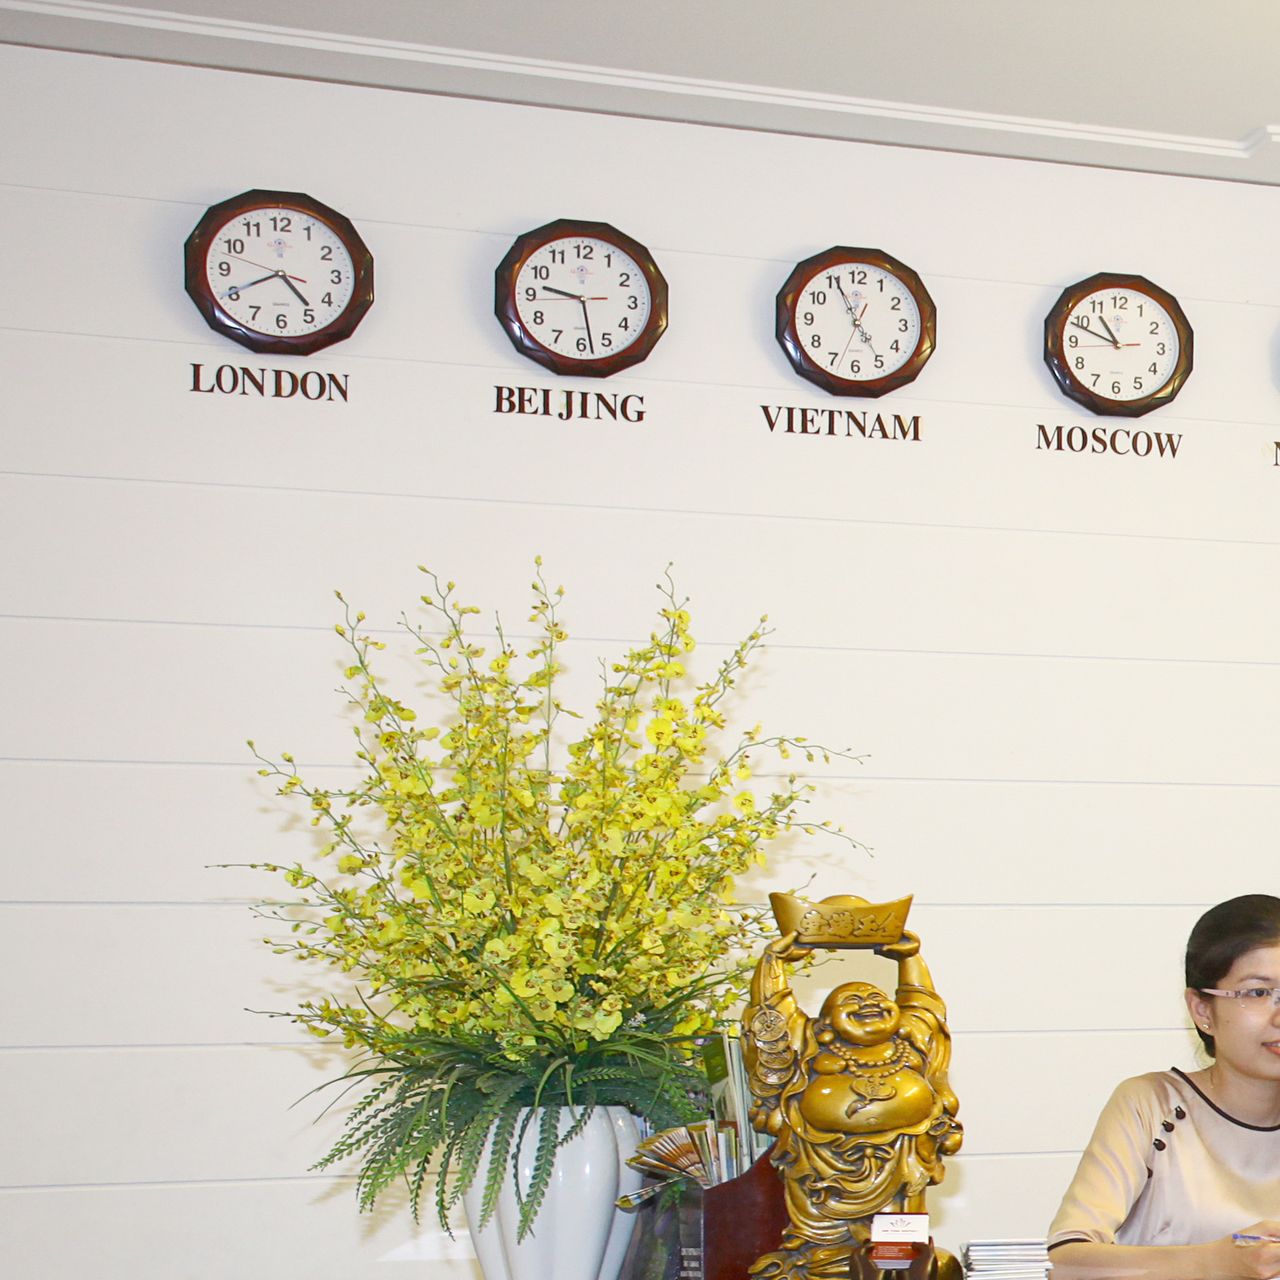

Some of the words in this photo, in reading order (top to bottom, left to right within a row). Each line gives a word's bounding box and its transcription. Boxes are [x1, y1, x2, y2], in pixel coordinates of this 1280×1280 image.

[243, 222, 260, 237] 11
[269, 217, 292, 233] 12
[303, 226, 311, 241] 1
[224, 238, 244, 254] 10
[574, 244, 593, 260] 12
[321, 246, 332, 261] 2
[549, 249, 565, 264] 11
[604, 253, 611, 268] 1
[219, 261, 231, 276] 9
[532, 265, 549, 280] 10
[331, 270, 342, 284] 3
[619, 273, 630, 287] 2
[849, 270, 867, 285] 12
[877, 279, 884, 292] 1
[321, 292, 333, 307] 4
[525, 287, 536, 301] 9
[810, 291, 826, 305] 10
[627, 296, 638, 309] 3
[891, 297, 901, 310] 2
[1090, 300, 1104, 313] 11
[1111, 296, 1128, 309] 12
[249, 306, 261, 321] 7
[303, 309, 315, 324] 5
[1137, 304, 1142, 317] 1
[276, 314, 287, 329] 6
[533, 311, 544, 325] 8
[618, 317, 629, 331] 4
[804, 312, 814, 326] 9
[898, 319, 908, 332] 3
[1150, 322, 1158, 334] 2
[552, 329, 563, 344] 7
[601, 333, 612, 347] 5
[811, 335, 821, 348] 8
[1069, 335, 1078, 348] 9
[576, 338, 586, 352] 6
[890, 339, 900, 353] 4
[1156, 342, 1165, 355] 3
[828, 353, 838, 366] 7
[851, 360, 860, 373] 6
[874, 355, 884, 368] 5
[1075, 357, 1084, 369] 8
[1148, 362, 1157, 375] 4
[189, 362, 350, 402] LONDON
[1091, 374, 1100, 387] 7
[1112, 381, 1120, 394] 6
[1133, 377, 1142, 389] 5
[492, 385, 647, 423] BEIJING
[759, 405, 922, 442] VIETNAM
[1035, 424, 1183, 459] MOSCOW
